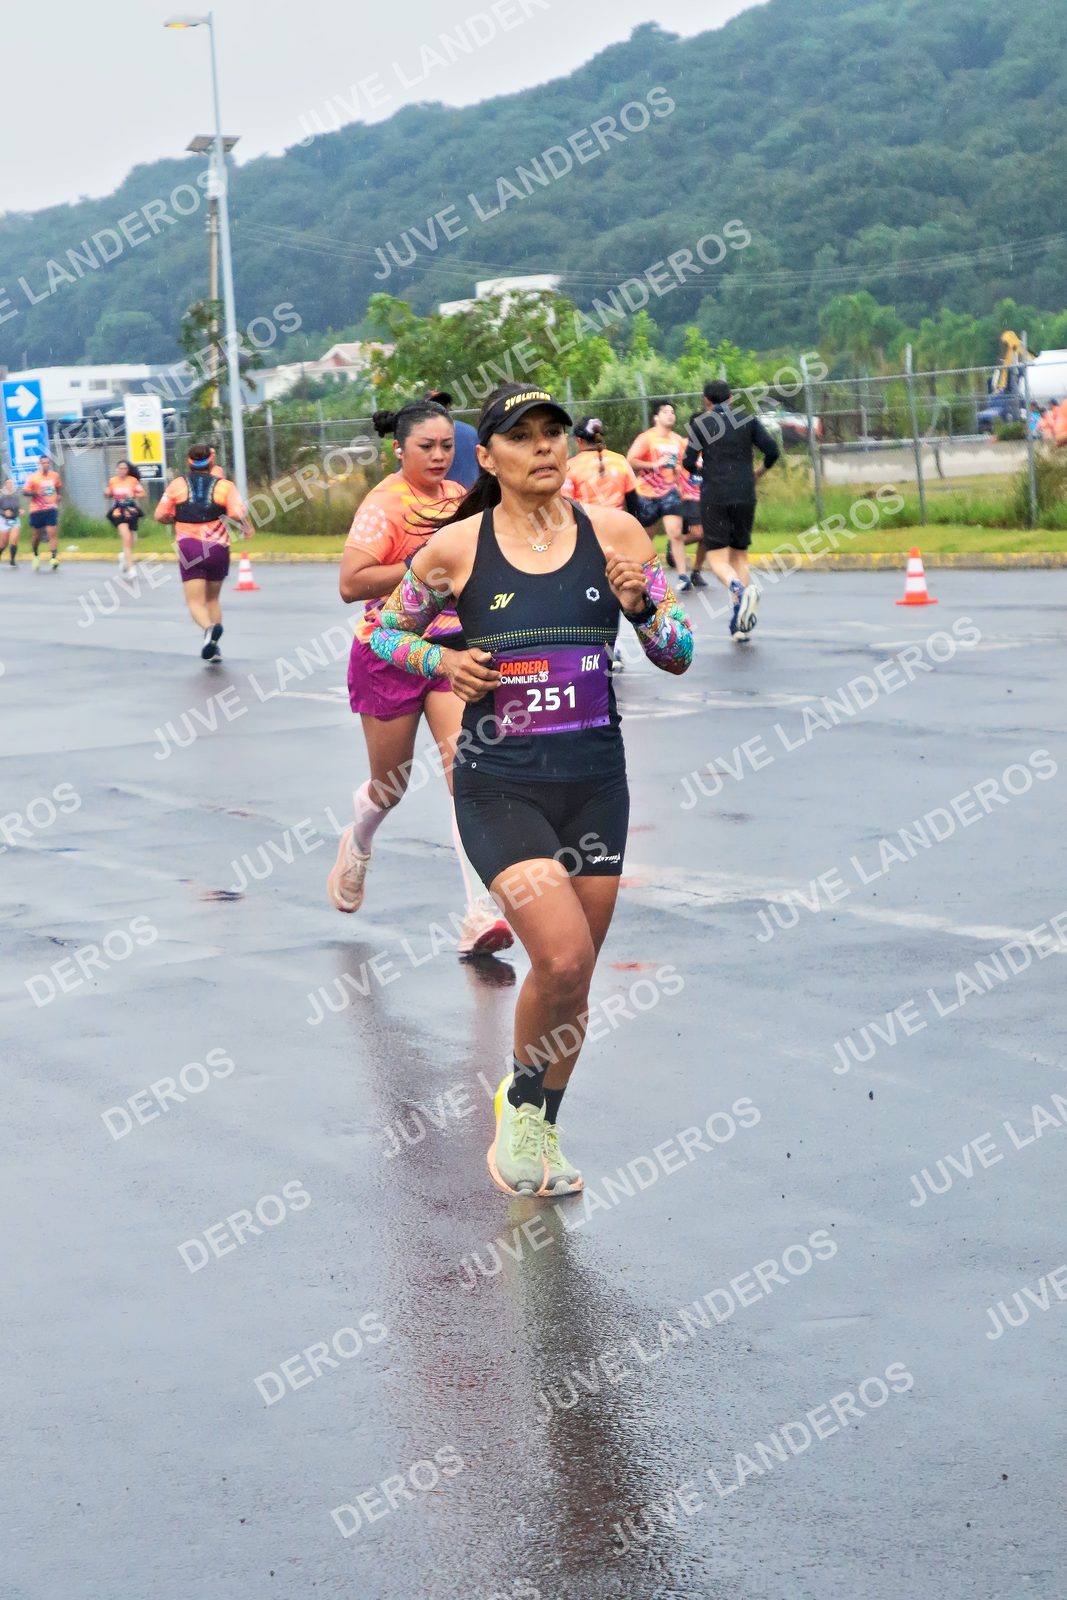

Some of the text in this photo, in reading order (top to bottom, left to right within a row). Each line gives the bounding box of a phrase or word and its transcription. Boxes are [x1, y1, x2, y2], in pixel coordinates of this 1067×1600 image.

[13, 426, 42, 464] E
[490, 592, 515, 610] 3V
[500, 659, 549, 675] CARRERA
[581, 653, 600, 672] 16K
[500, 674, 538, 685] OMNILIFE
[526, 685, 576, 712] 251
